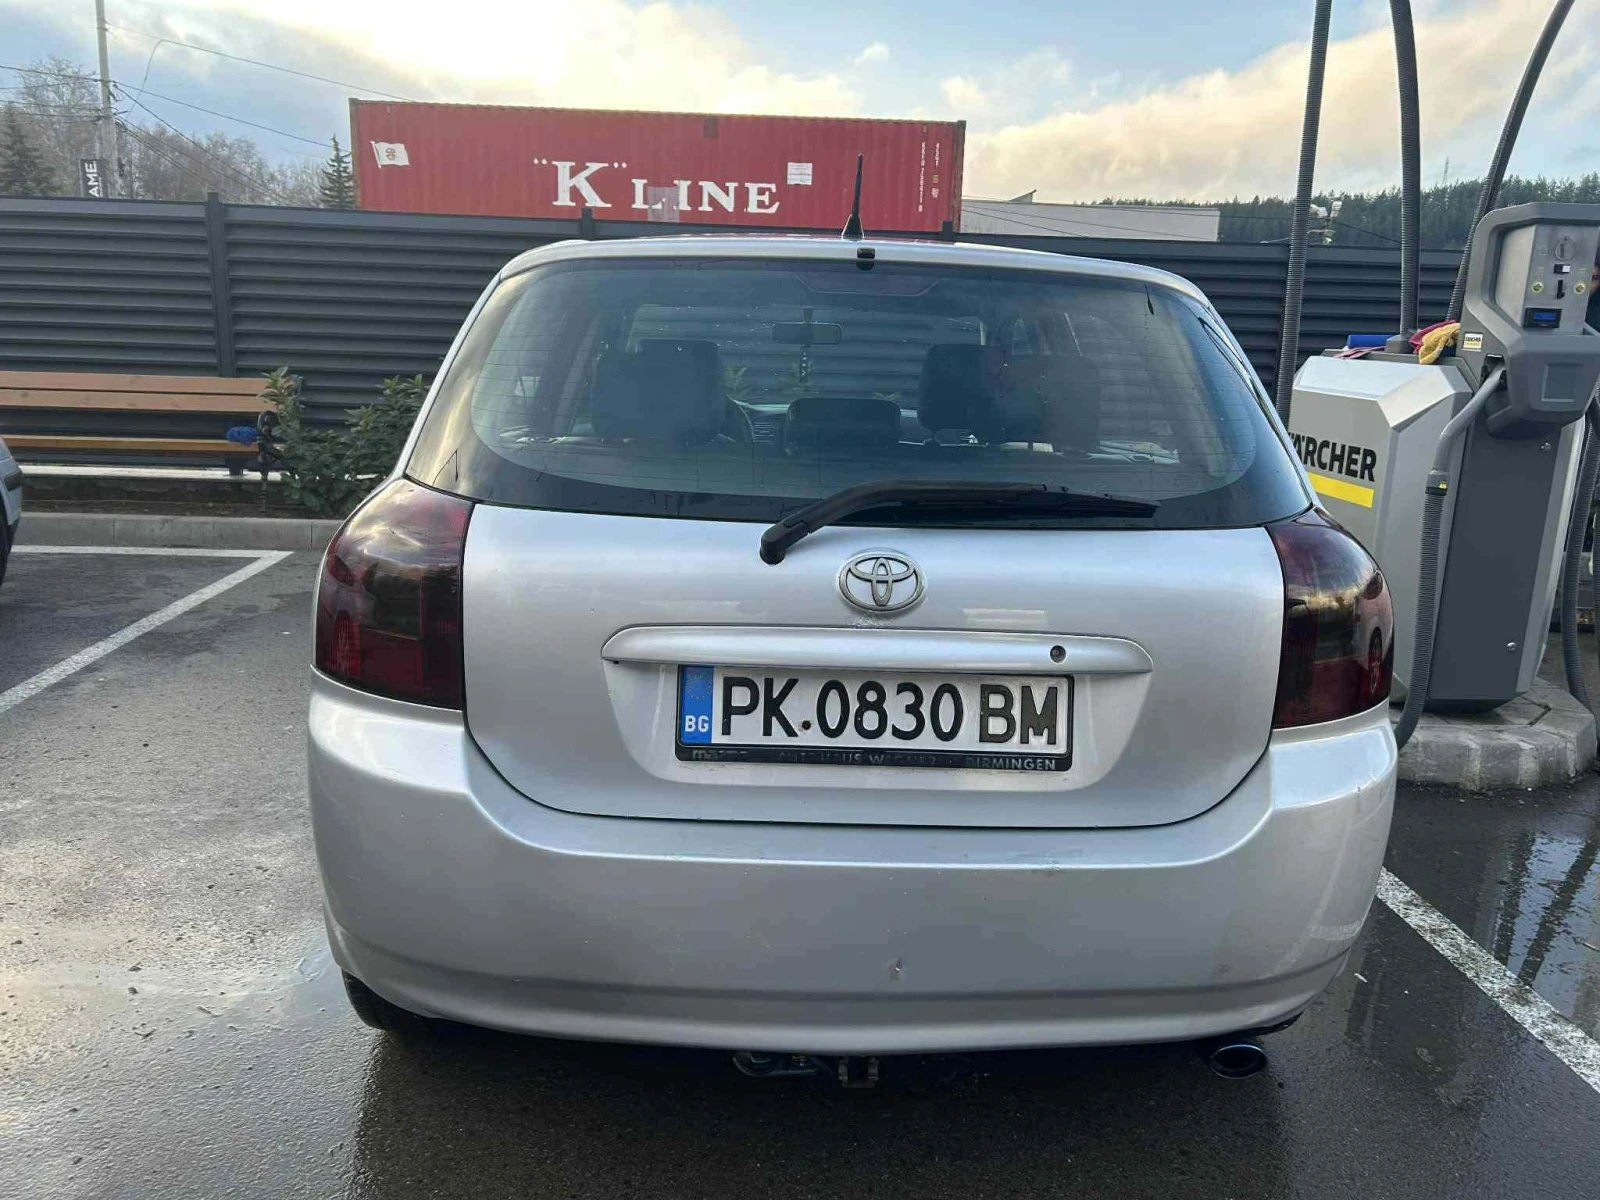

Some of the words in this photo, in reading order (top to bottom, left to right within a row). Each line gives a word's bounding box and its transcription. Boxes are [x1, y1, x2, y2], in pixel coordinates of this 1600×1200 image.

[85, 160, 99, 198] AME
[631, 178, 781, 214] LINE
[1287, 431, 1377, 482] ÄRCHER
[684, 714, 710, 732] BG
[721, 676, 800, 737] PK
[816, 679, 964, 742] 0830
[979, 684, 1058, 745] BM
